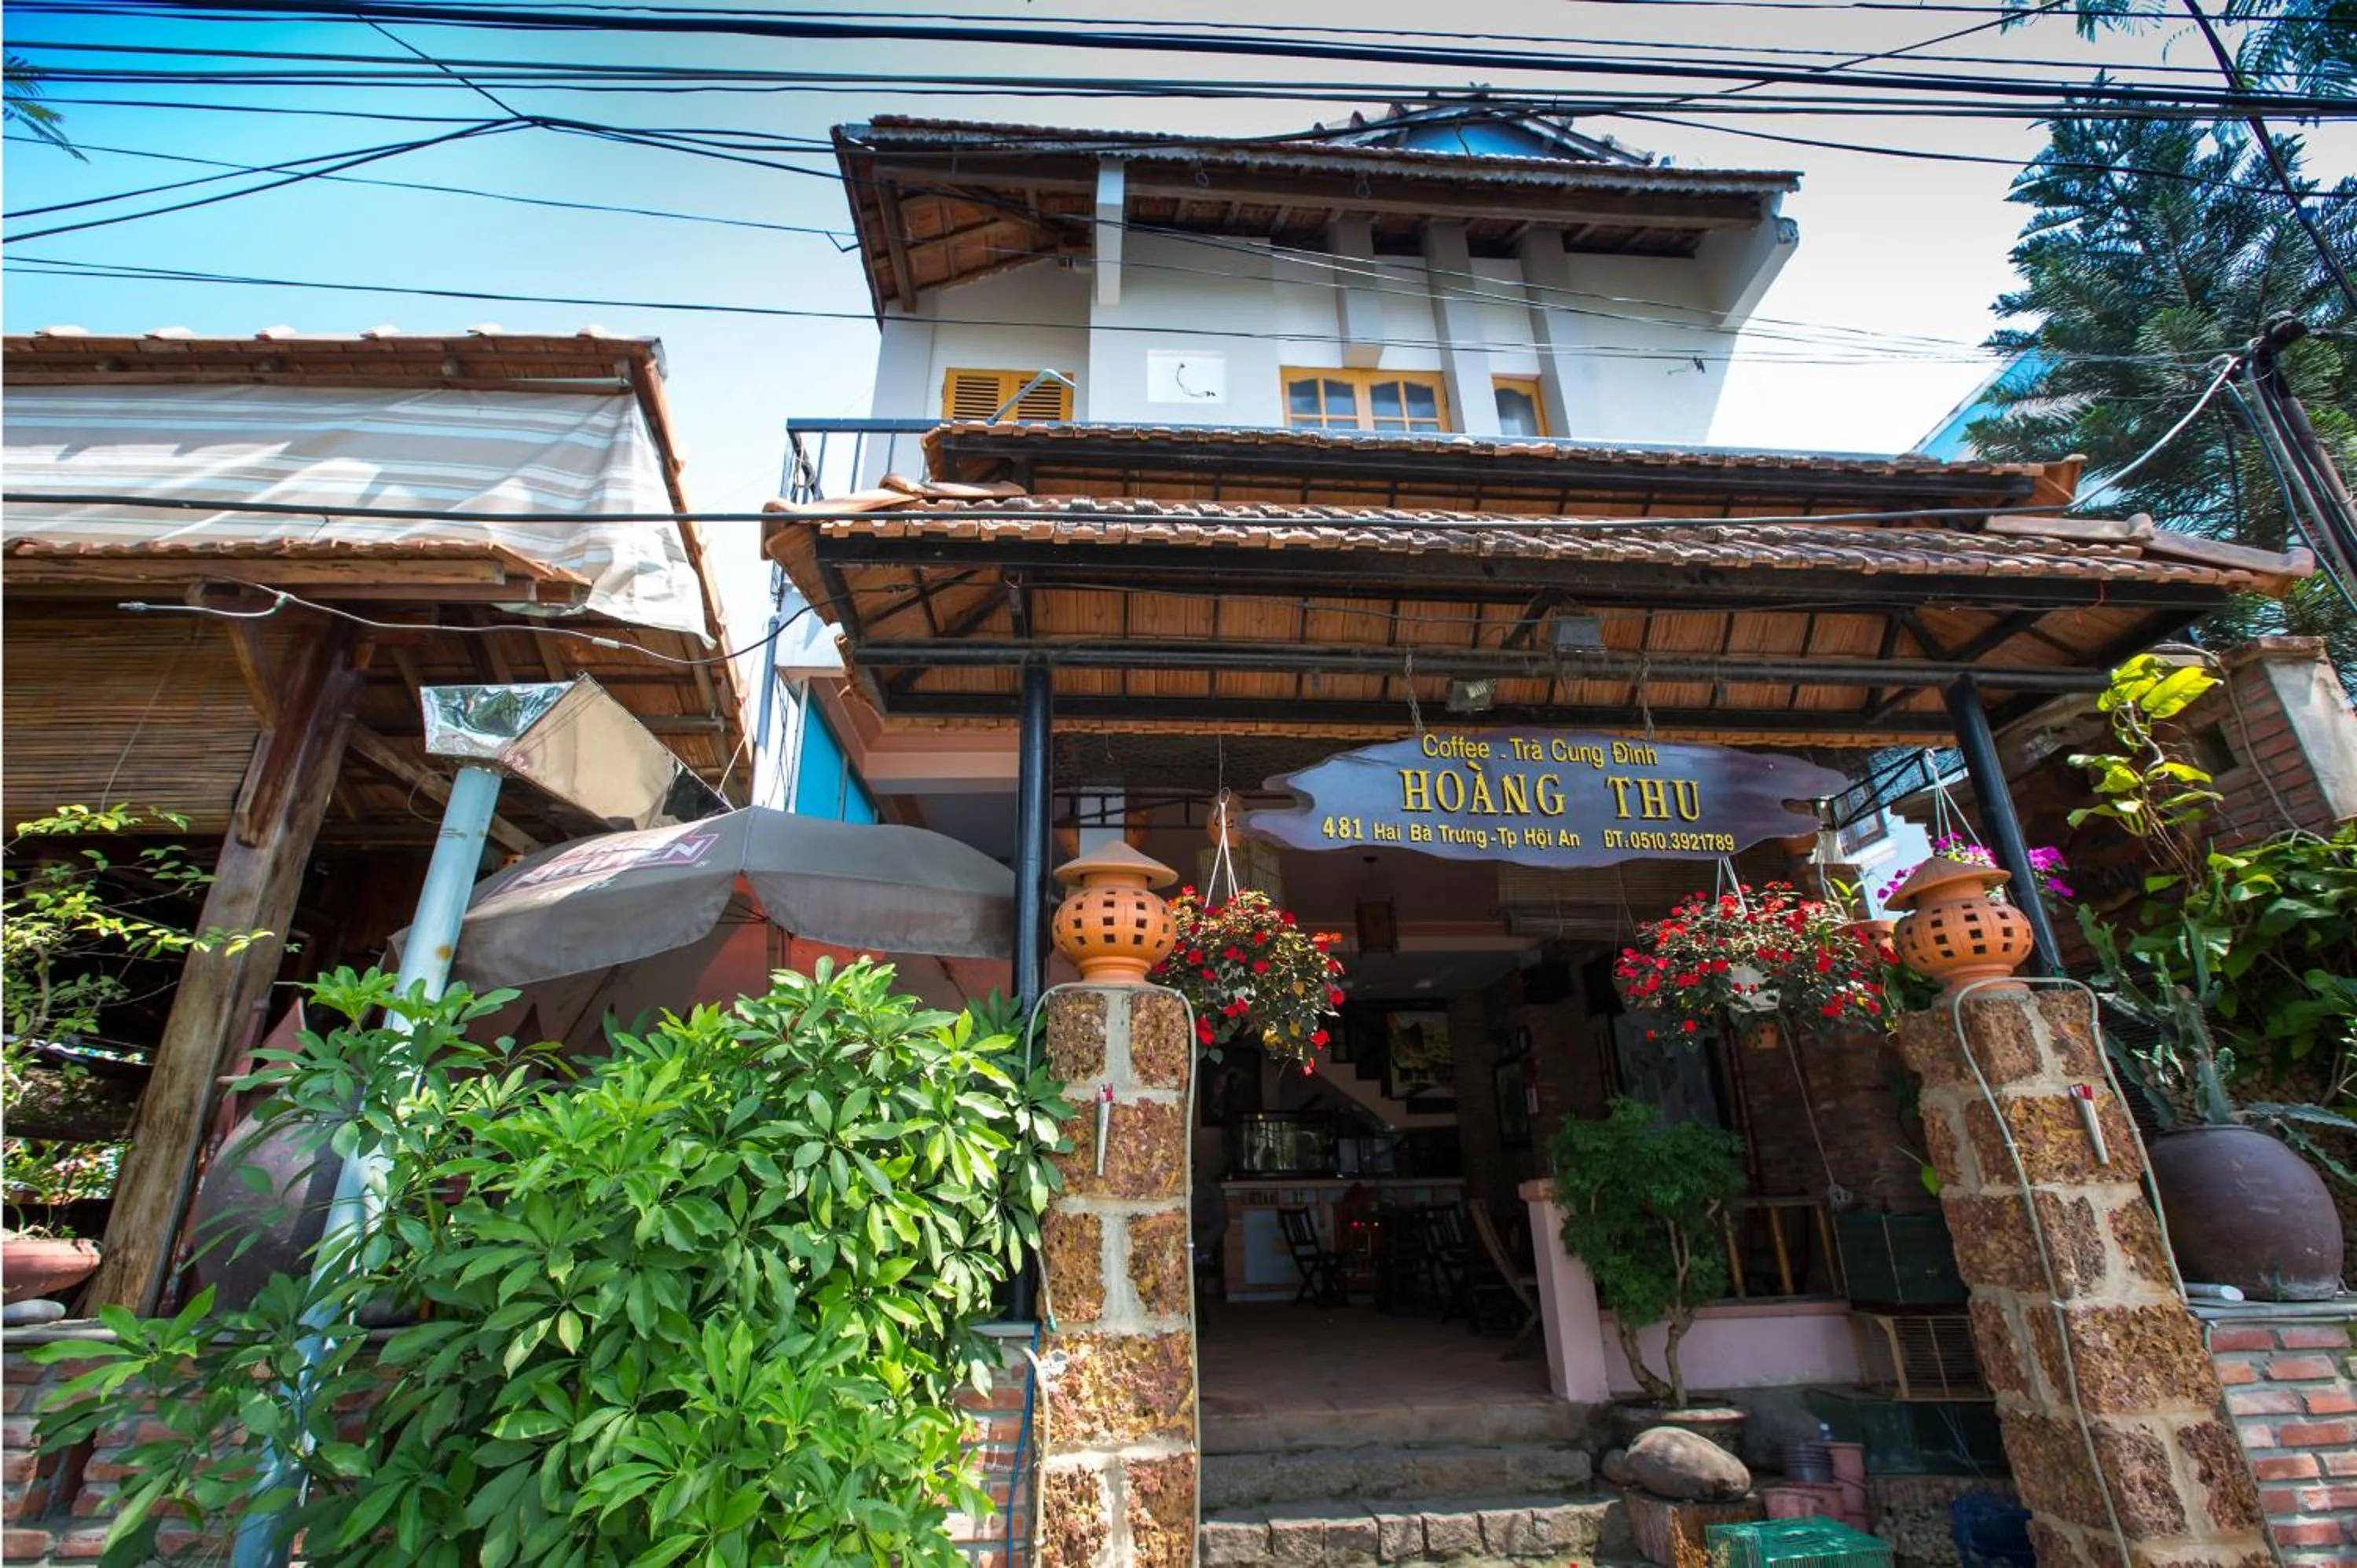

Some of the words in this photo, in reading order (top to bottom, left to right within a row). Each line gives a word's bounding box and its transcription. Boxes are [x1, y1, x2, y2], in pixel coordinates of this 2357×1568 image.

[1422, 734, 1490, 759] Coffee
[1509, 737, 1544, 760] Trà
[1552, 739, 1604, 768] Cung
[1611, 741, 1659, 765] Đình
[1399, 760, 1567, 815] HOÀNG
[1605, 775, 1700, 821] THU
[1322, 816, 1364, 840] 481
[1373, 822, 1402, 841] Hai
[1410, 823, 1432, 843] Bà
[1523, 828, 1552, 849] Hội
[1558, 829, 1581, 847] An
